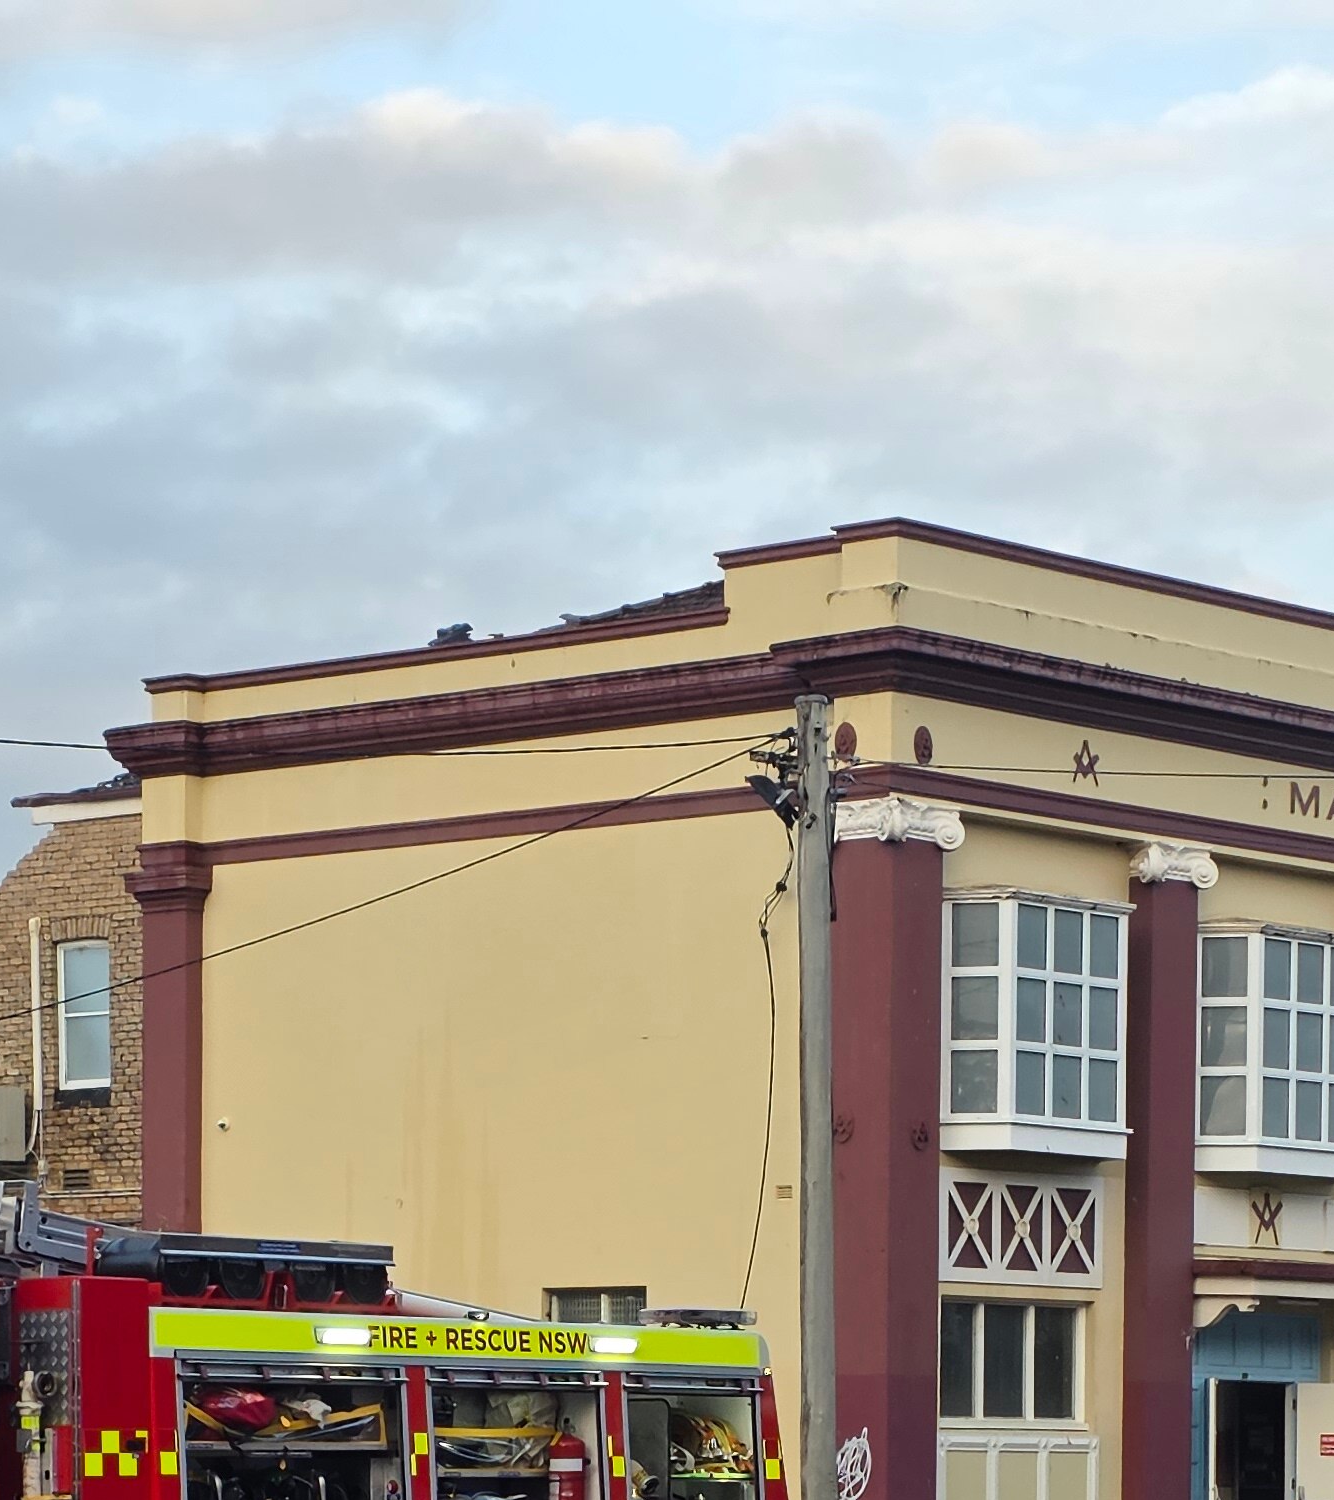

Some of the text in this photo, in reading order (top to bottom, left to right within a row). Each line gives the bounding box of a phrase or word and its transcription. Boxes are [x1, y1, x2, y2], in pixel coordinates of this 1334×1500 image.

[367, 1325, 418, 1348] FIRE
[446, 1327, 531, 1352] RESCUE
[539, 1331, 588, 1354] NSW
